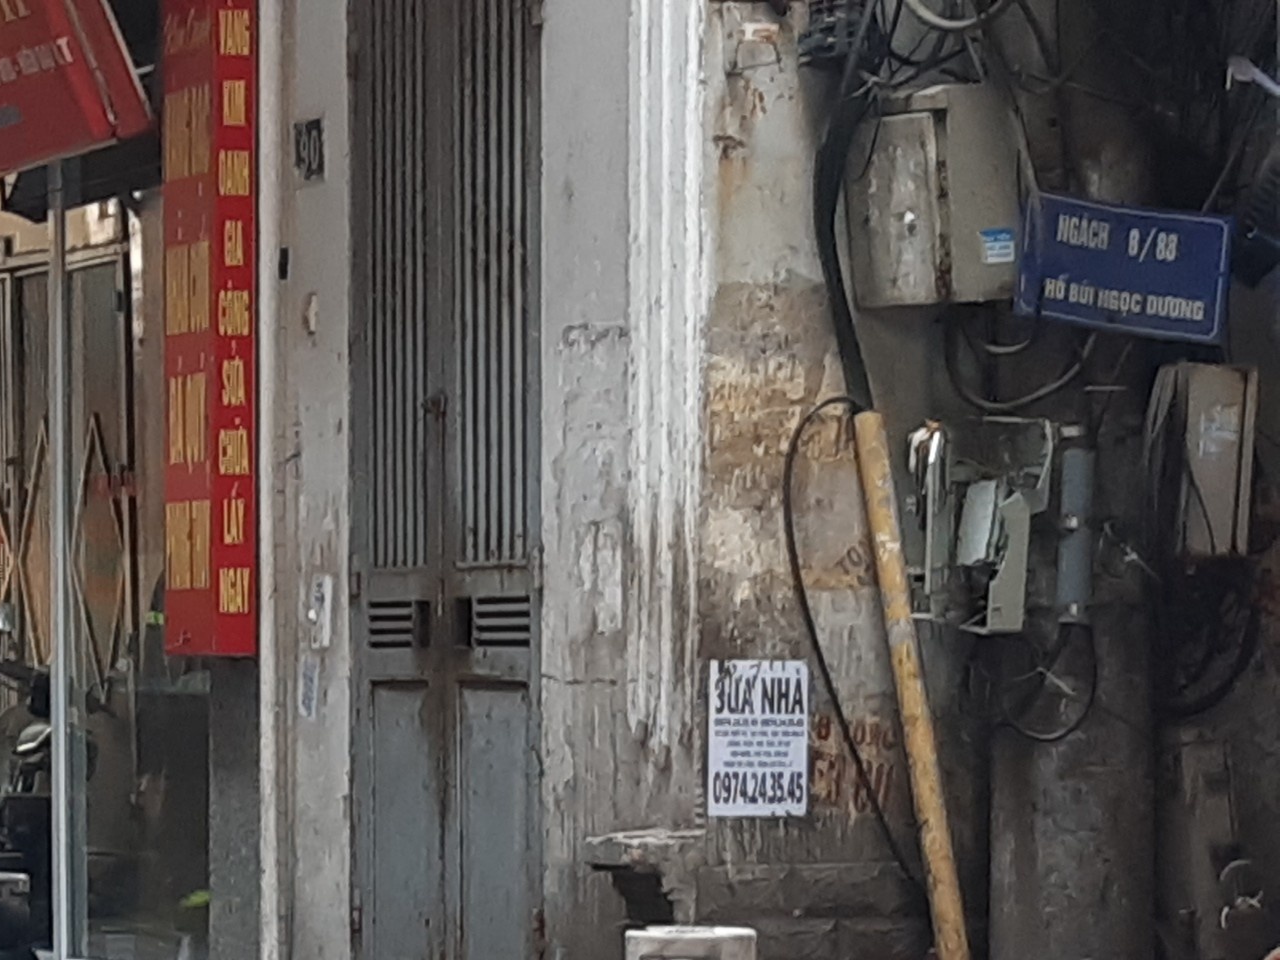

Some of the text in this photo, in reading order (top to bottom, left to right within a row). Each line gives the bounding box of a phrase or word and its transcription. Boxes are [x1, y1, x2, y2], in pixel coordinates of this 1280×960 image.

[223, 80, 245, 125] KIM
[219, 149, 249, 195] OANH
[224, 220, 243, 266] GIA
[219, 567, 249, 613] NGAY
[761, 667, 805, 715] NHÀ
